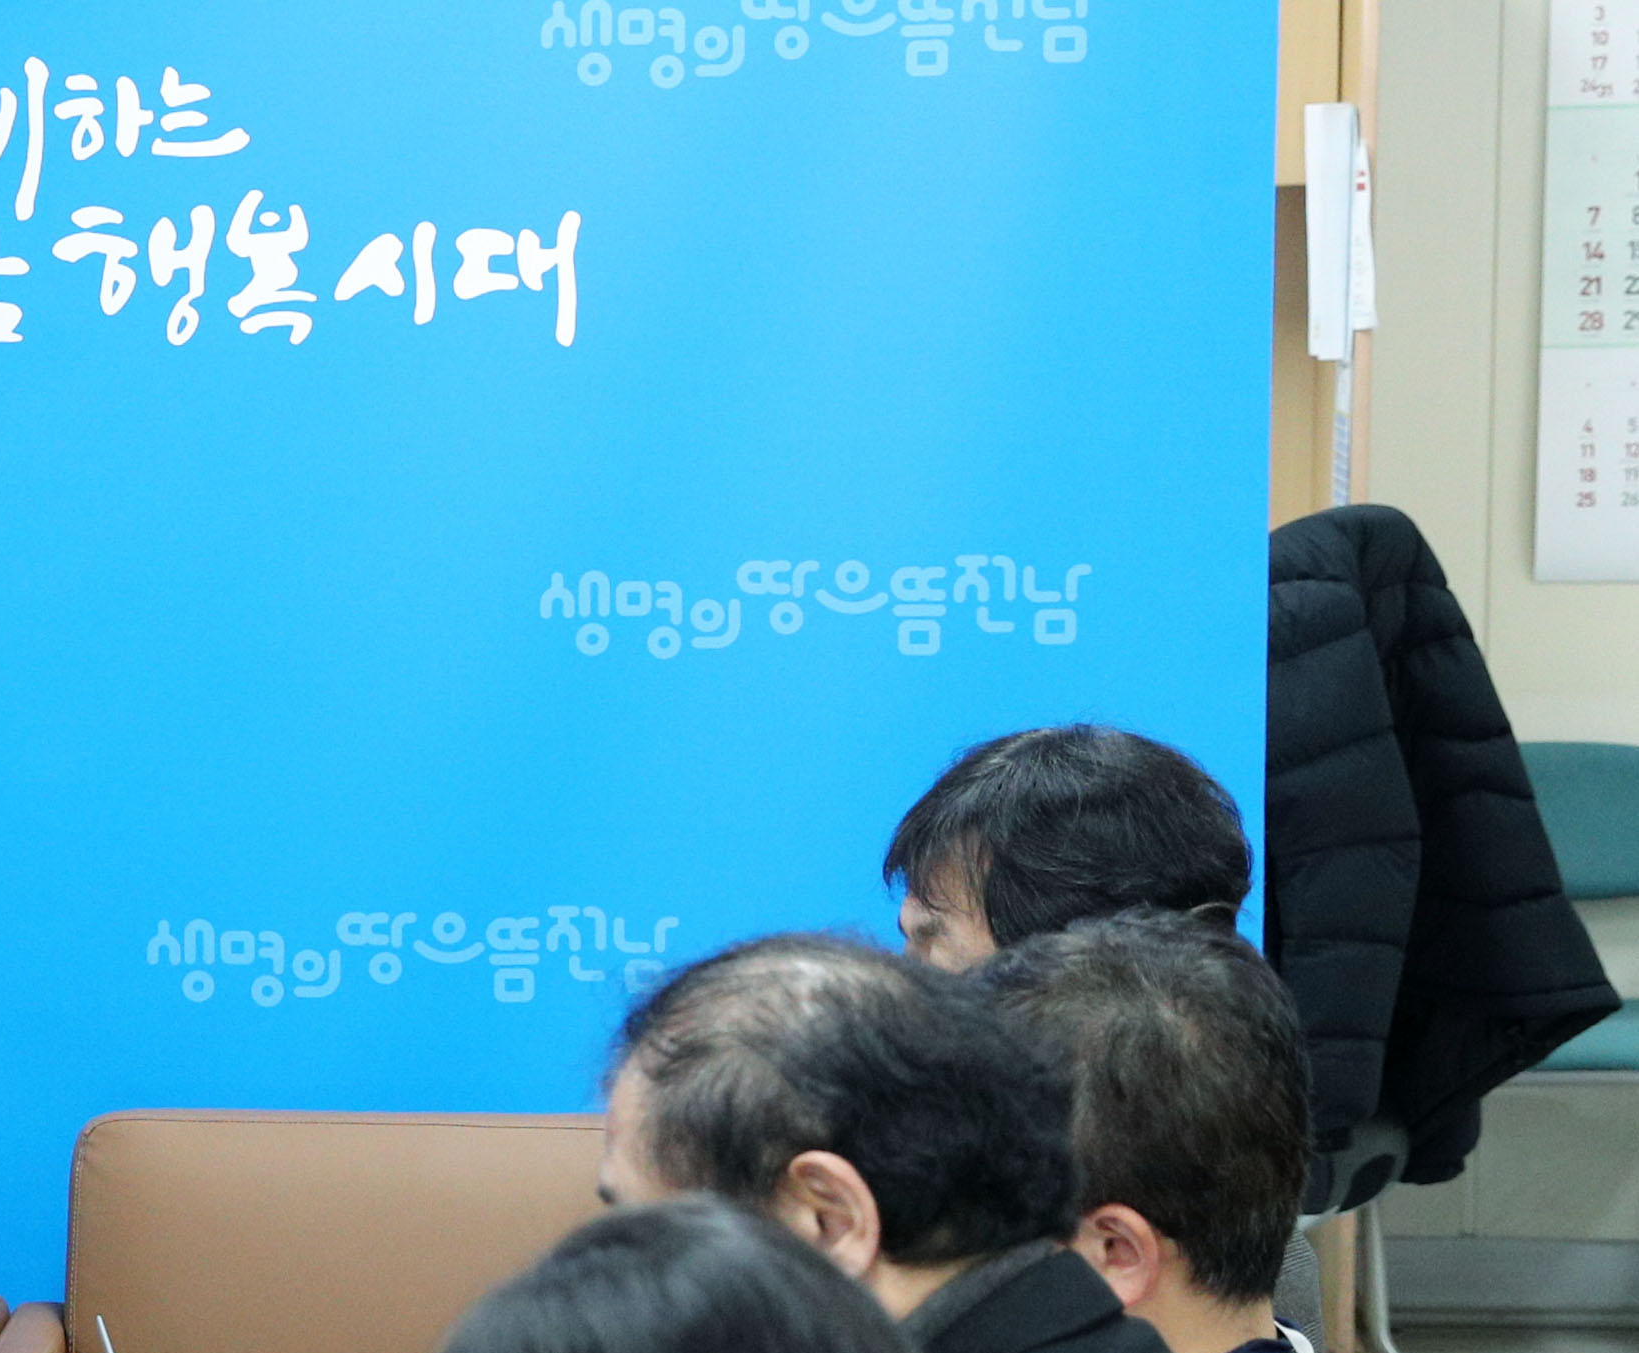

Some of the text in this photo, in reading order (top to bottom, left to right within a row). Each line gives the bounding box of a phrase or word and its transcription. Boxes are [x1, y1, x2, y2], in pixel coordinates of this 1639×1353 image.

[1586, 206, 1602, 226] 7
[1582, 242, 1605, 260] 14
[1580, 276, 1603, 296] 21
[1578, 310, 1604, 331] 28
